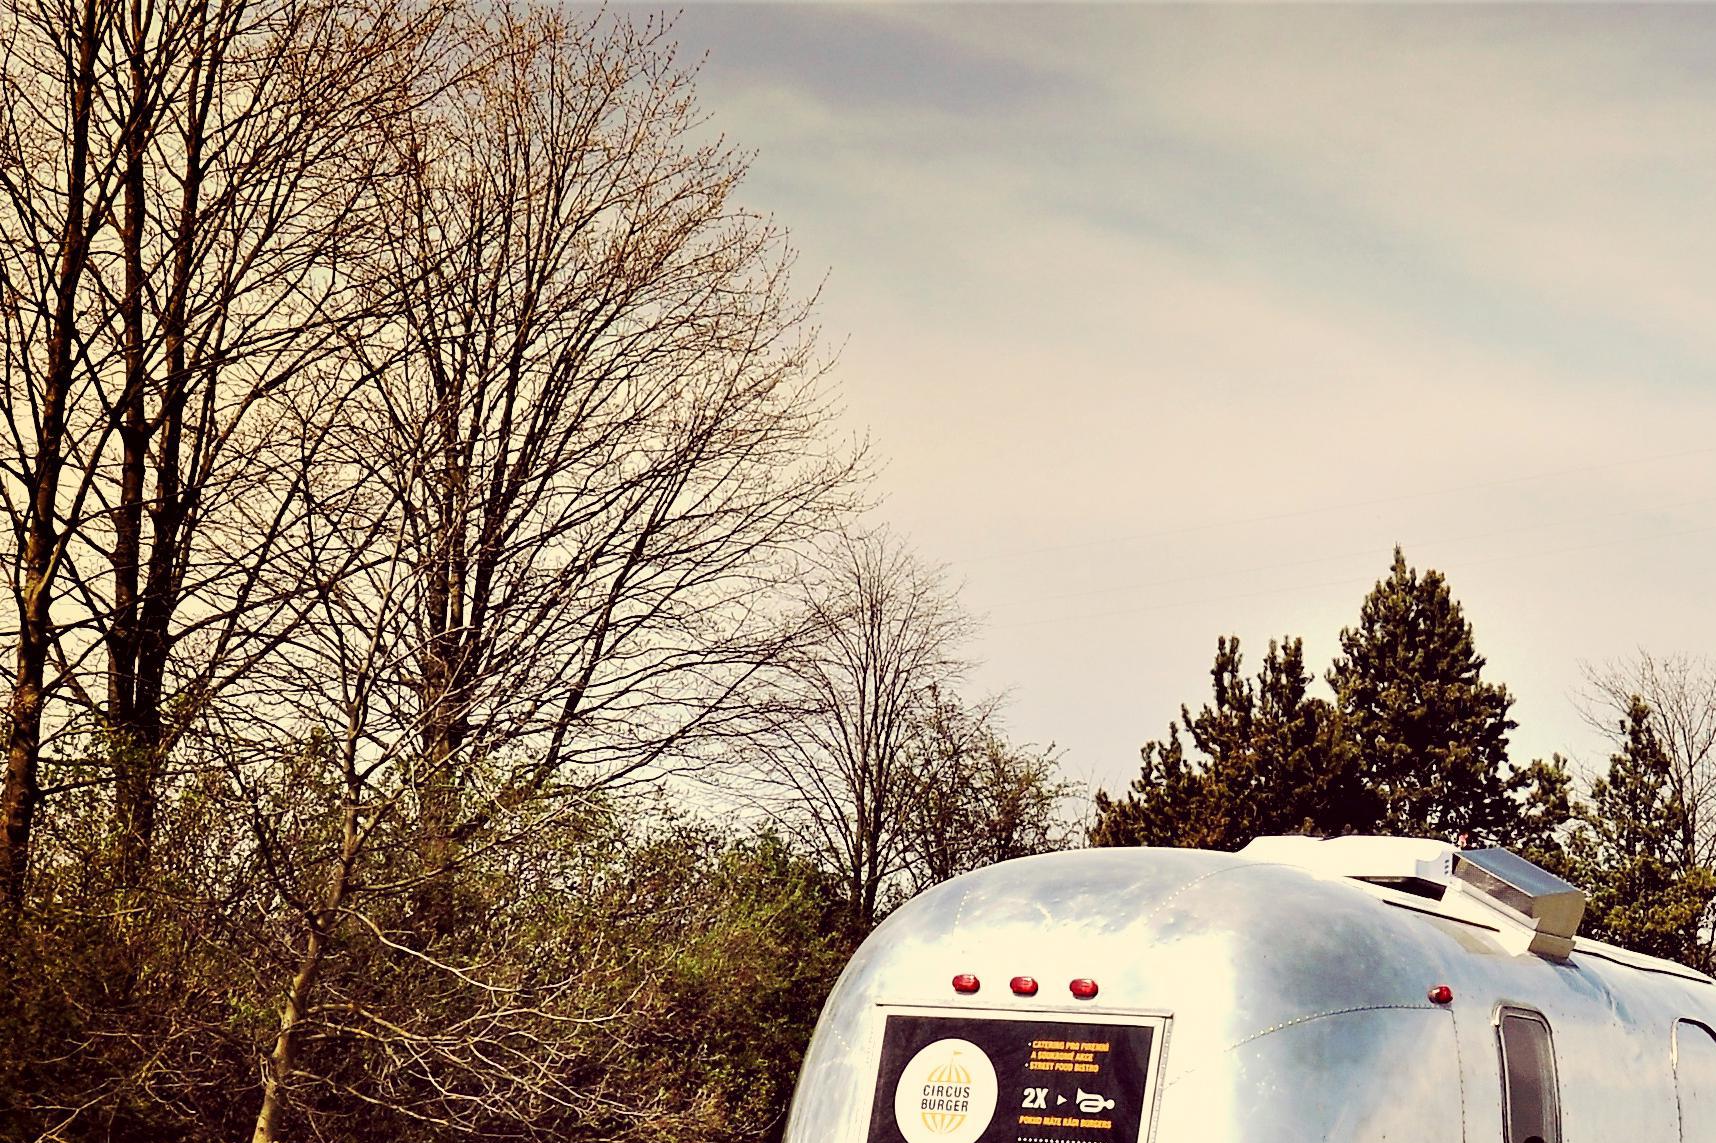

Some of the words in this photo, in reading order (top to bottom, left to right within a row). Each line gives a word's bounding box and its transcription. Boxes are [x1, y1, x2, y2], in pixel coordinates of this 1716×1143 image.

[923, 1085, 970, 1098] CIRCUS
[1021, 1088, 1048, 1109] 2X
[921, 1099, 968, 1112] BURGER
